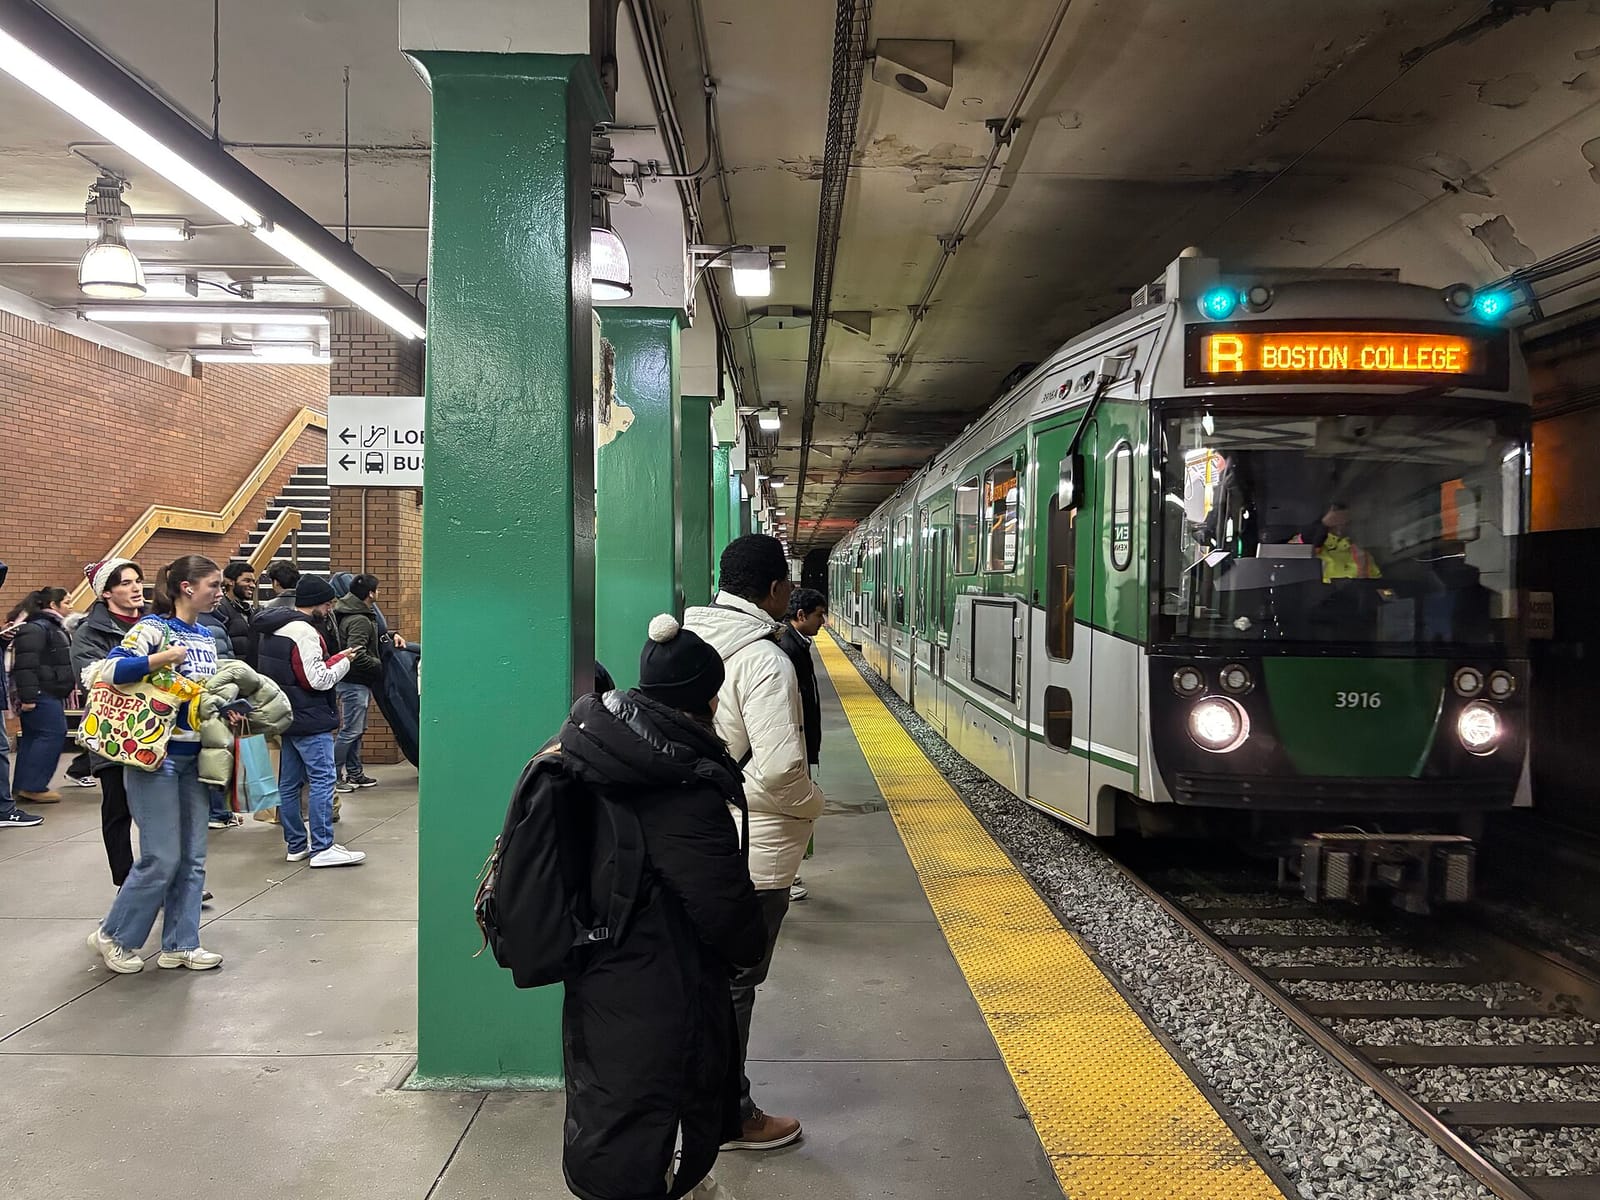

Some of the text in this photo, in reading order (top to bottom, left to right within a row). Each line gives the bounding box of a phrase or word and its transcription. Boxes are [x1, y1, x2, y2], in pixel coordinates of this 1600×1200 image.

[1211, 334, 1461, 375] R BOSTON COLLEGE
[93, 690, 144, 712] TRADER
[1335, 692, 1382, 708] 3916
[96, 704, 129, 721] JOE'S
